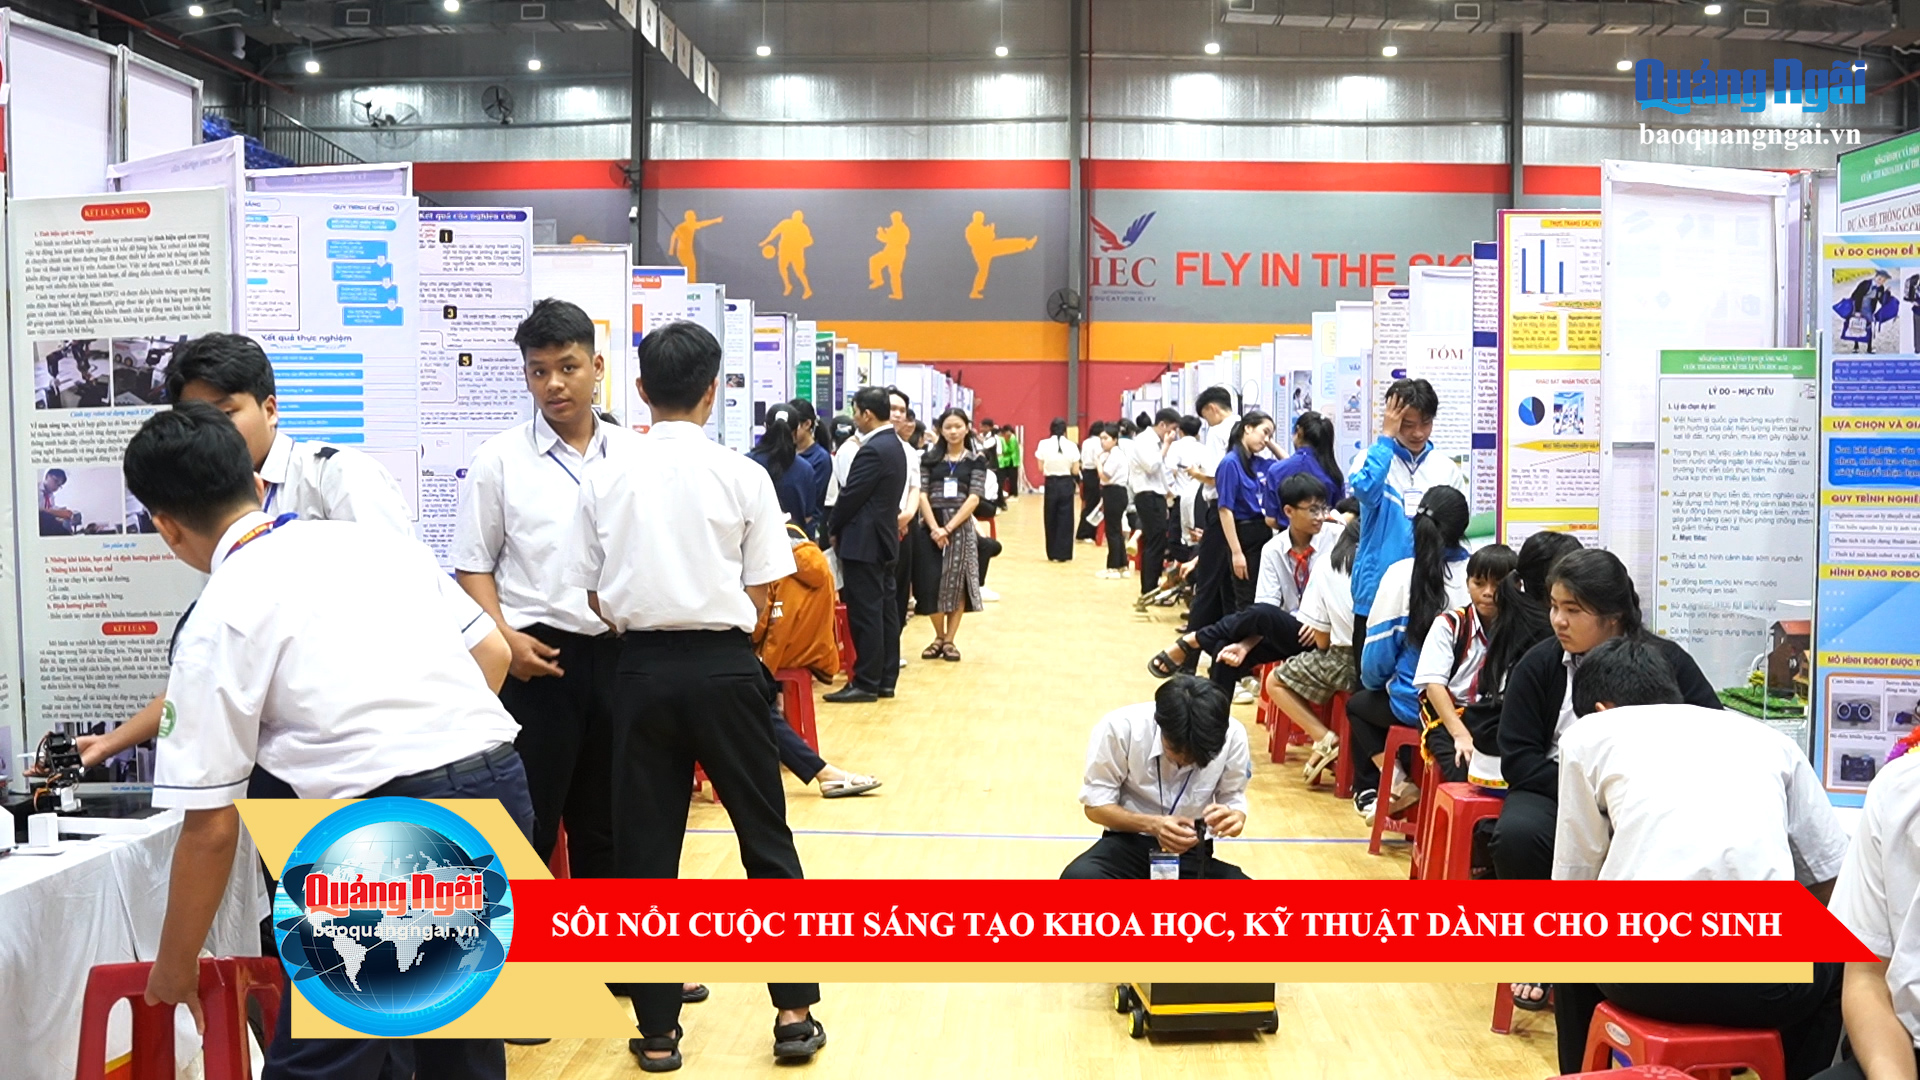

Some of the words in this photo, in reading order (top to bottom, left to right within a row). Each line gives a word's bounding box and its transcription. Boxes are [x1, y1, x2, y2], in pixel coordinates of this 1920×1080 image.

[1834, 246, 1845, 256] LÝ
[1848, 247, 1863, 256] DO
[1866, 247, 1897, 258] CHỌN
[1901, 243, 1914, 256] ĐỀ
[1090, 256, 1156, 288] IEC
[1177, 252, 1251, 286] FLY
[1262, 252, 1300, 286] IN
[1313, 252, 1396, 287] THE
[261, 333, 275, 341] Kết
[278, 333, 295, 343] quả
[297, 334, 317, 343] thực
[319, 334, 352, 343] nghiệm
[1427, 344, 1464, 361] TÓM
[1708, 385, 1718, 396] LÝ
[1719, 387, 1731, 396] DO
[1738, 387, 1755, 397] MỤC
[1757, 385, 1775, 396] TIÊU
[1832, 420, 1851, 431] LỰA
[1854, 420, 1885, 431] CHỌN
[1888, 418, 1903, 429] VÀ
[1831, 494, 1852, 504] QUY
[1855, 493, 1884, 503] TRÌNH
[1830, 567, 1854, 577] HÌNH
[1857, 569, 1888, 580] DẠNG
[113, 624, 126, 632] KẾT
[127, 624, 147, 632] LUẬN
[1828, 655, 1840, 664] MÔ
[1842, 655, 1861, 665] HÌNH
[1863, 657, 1888, 665] ROBOT
[1890, 657, 1913, 667] ĐƯỢC
